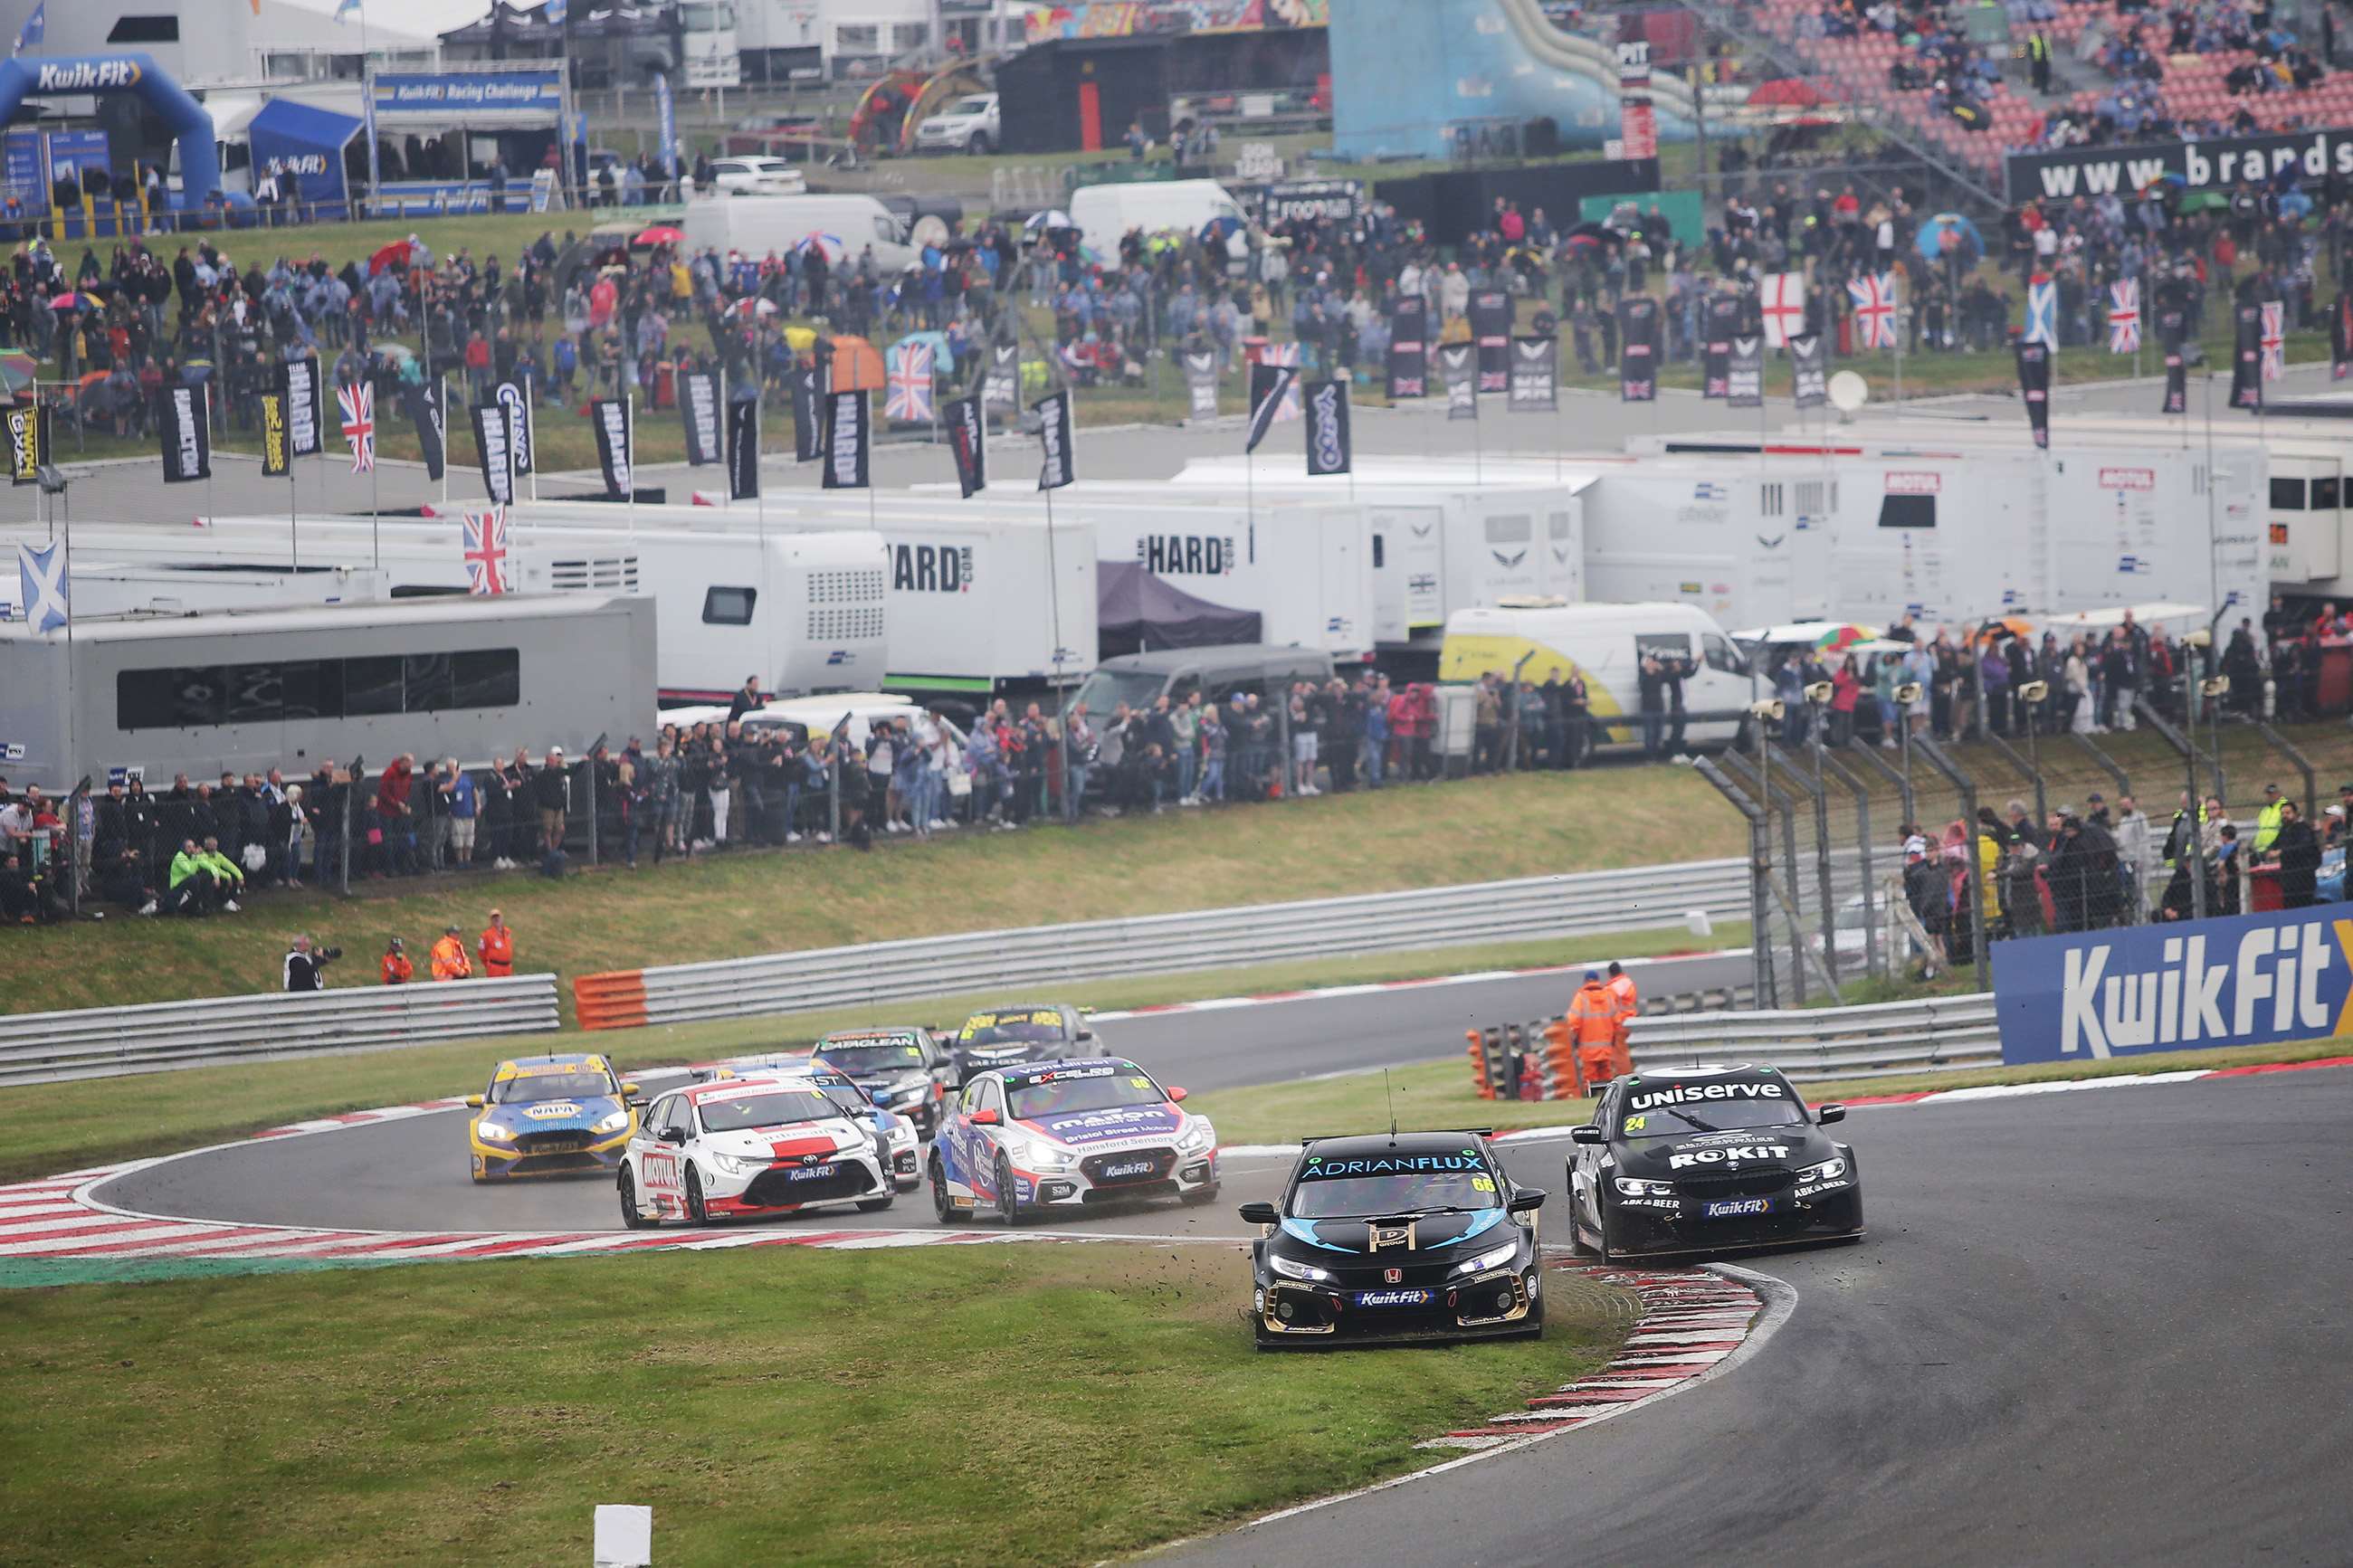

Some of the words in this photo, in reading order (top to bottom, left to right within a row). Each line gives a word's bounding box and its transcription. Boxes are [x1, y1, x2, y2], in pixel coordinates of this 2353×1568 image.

[290, 372, 314, 440] HARD
[691, 384, 716, 448] HARD
[174, 388, 199, 477] HAMILTON
[834, 404, 857, 470] HARD
[483, 418, 509, 489] HARD
[887, 544, 959, 593] ARD
[1148, 535, 1222, 575] HARD
[532, 1104, 574, 1116] NAPA
[1624, 1117, 1646, 1132] 24
[1064, 1131, 1103, 1144] Bristol
[1104, 1126, 1138, 1136] Street
[1140, 1125, 1175, 1133] Motors
[1077, 1139, 1128, 1155] Hansford
[1130, 1136, 1175, 1145] Sensors
[644, 1156, 678, 1188] MOTUL
[1052, 1185, 1071, 1195] S2M
[1653, 1200, 1681, 1209] BEER
[1794, 1186, 1815, 1199] ABK
